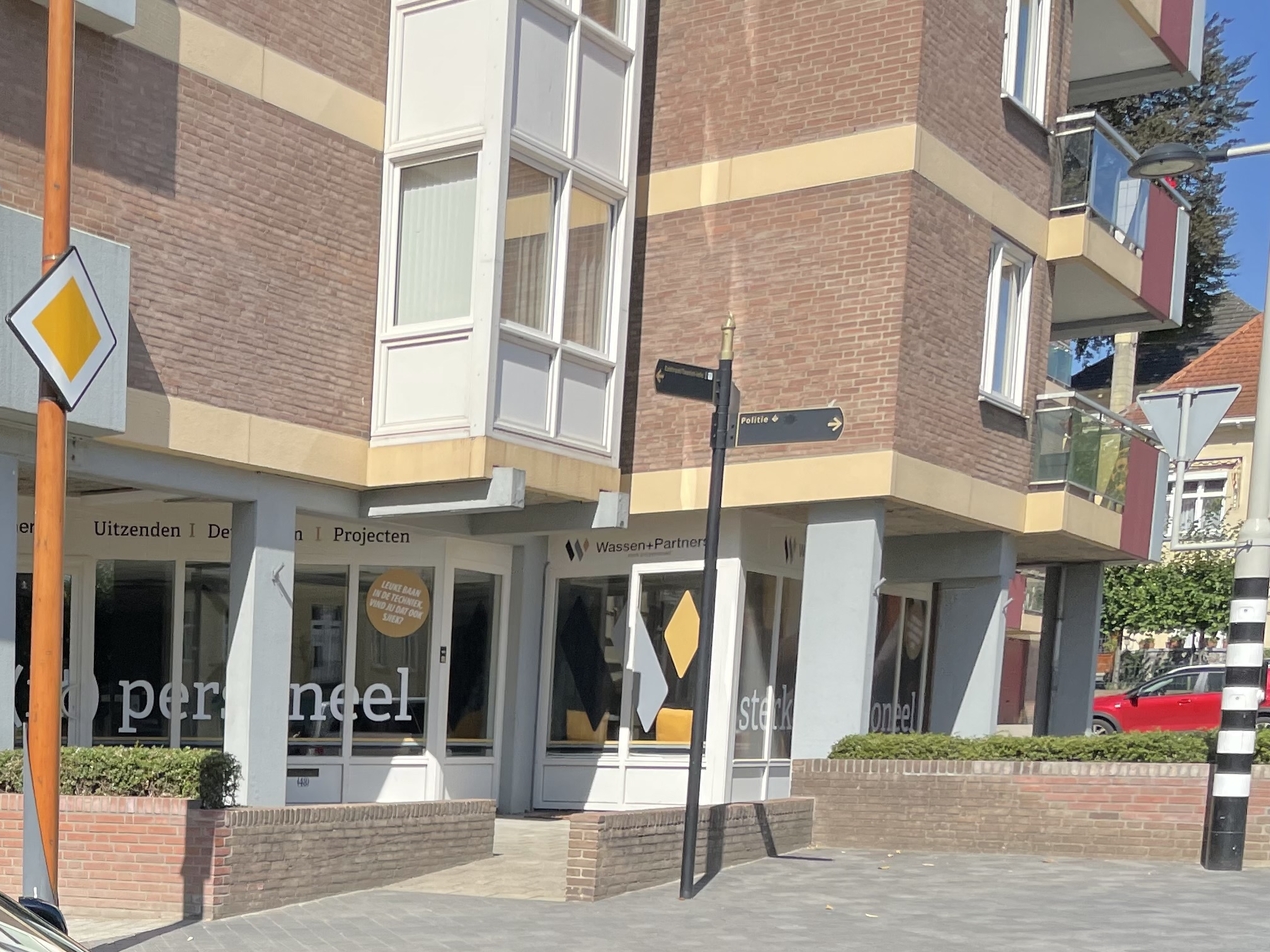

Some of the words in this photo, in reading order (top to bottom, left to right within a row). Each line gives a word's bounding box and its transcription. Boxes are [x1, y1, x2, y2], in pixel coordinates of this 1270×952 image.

[740, 416, 769, 425] Politie
[94, 521, 182, 537] Uitzenden
[333, 527, 410, 546] Projecten
[372, 589, 381, 598] IN
[381, 592, 391, 600] DE
[381, 581, 402, 593] LEUKE
[402, 585, 422, 597] BAAN
[369, 598, 386, 610] VIND
[395, 605, 409, 615] DAT
[408, 609, 424, 619] OOK
